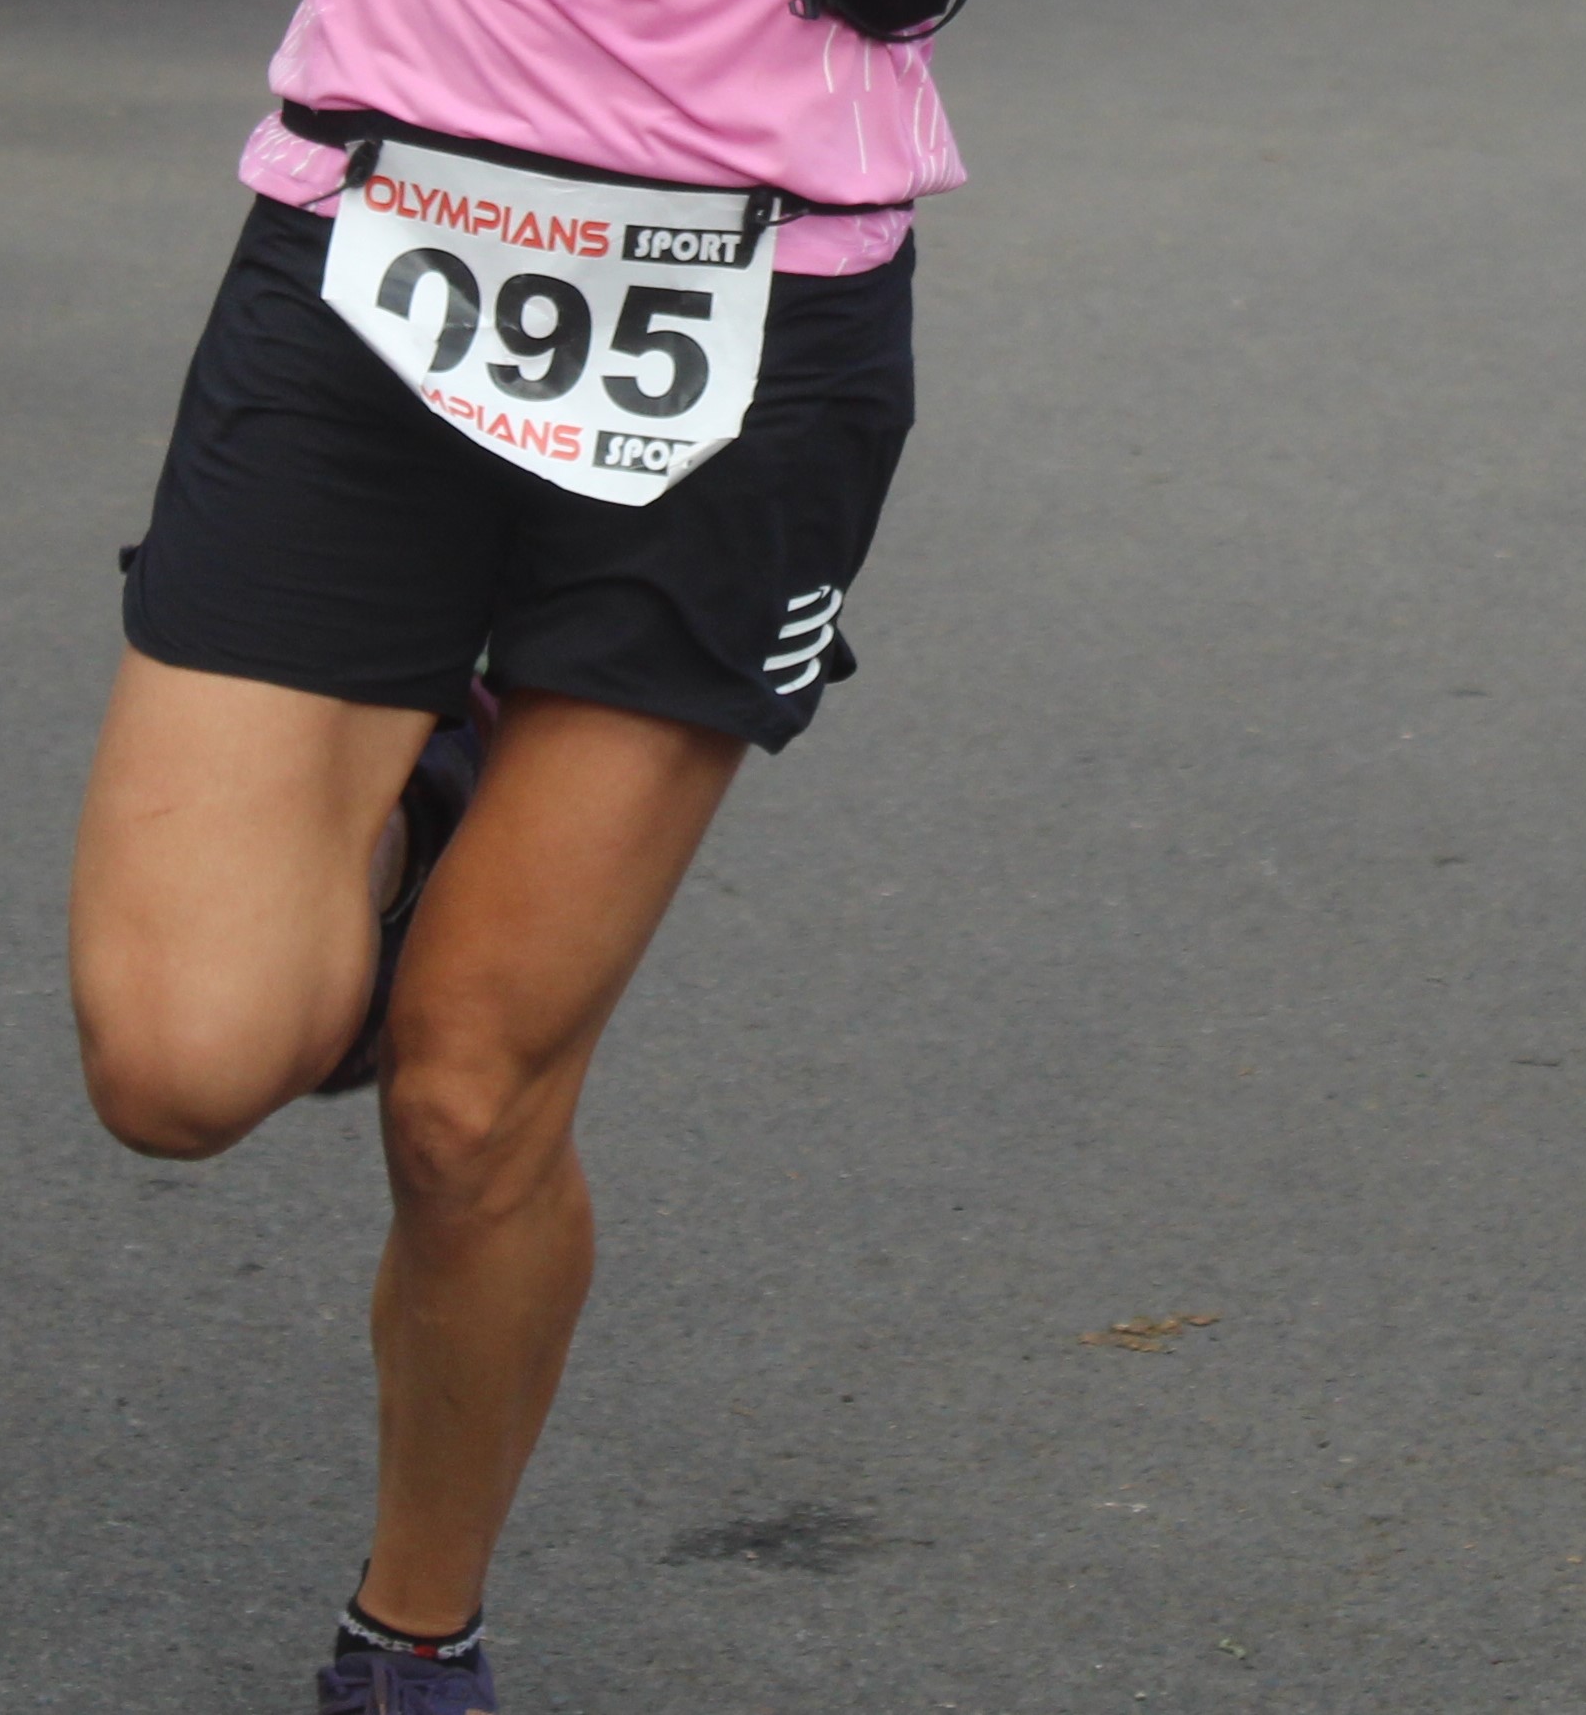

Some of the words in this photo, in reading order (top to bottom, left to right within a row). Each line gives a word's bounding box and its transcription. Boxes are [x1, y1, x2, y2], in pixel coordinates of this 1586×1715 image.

[363, 174, 611, 258] OLYMPIANS
[633, 229, 742, 263] SPORT
[604, 435, 690, 472] SPO
